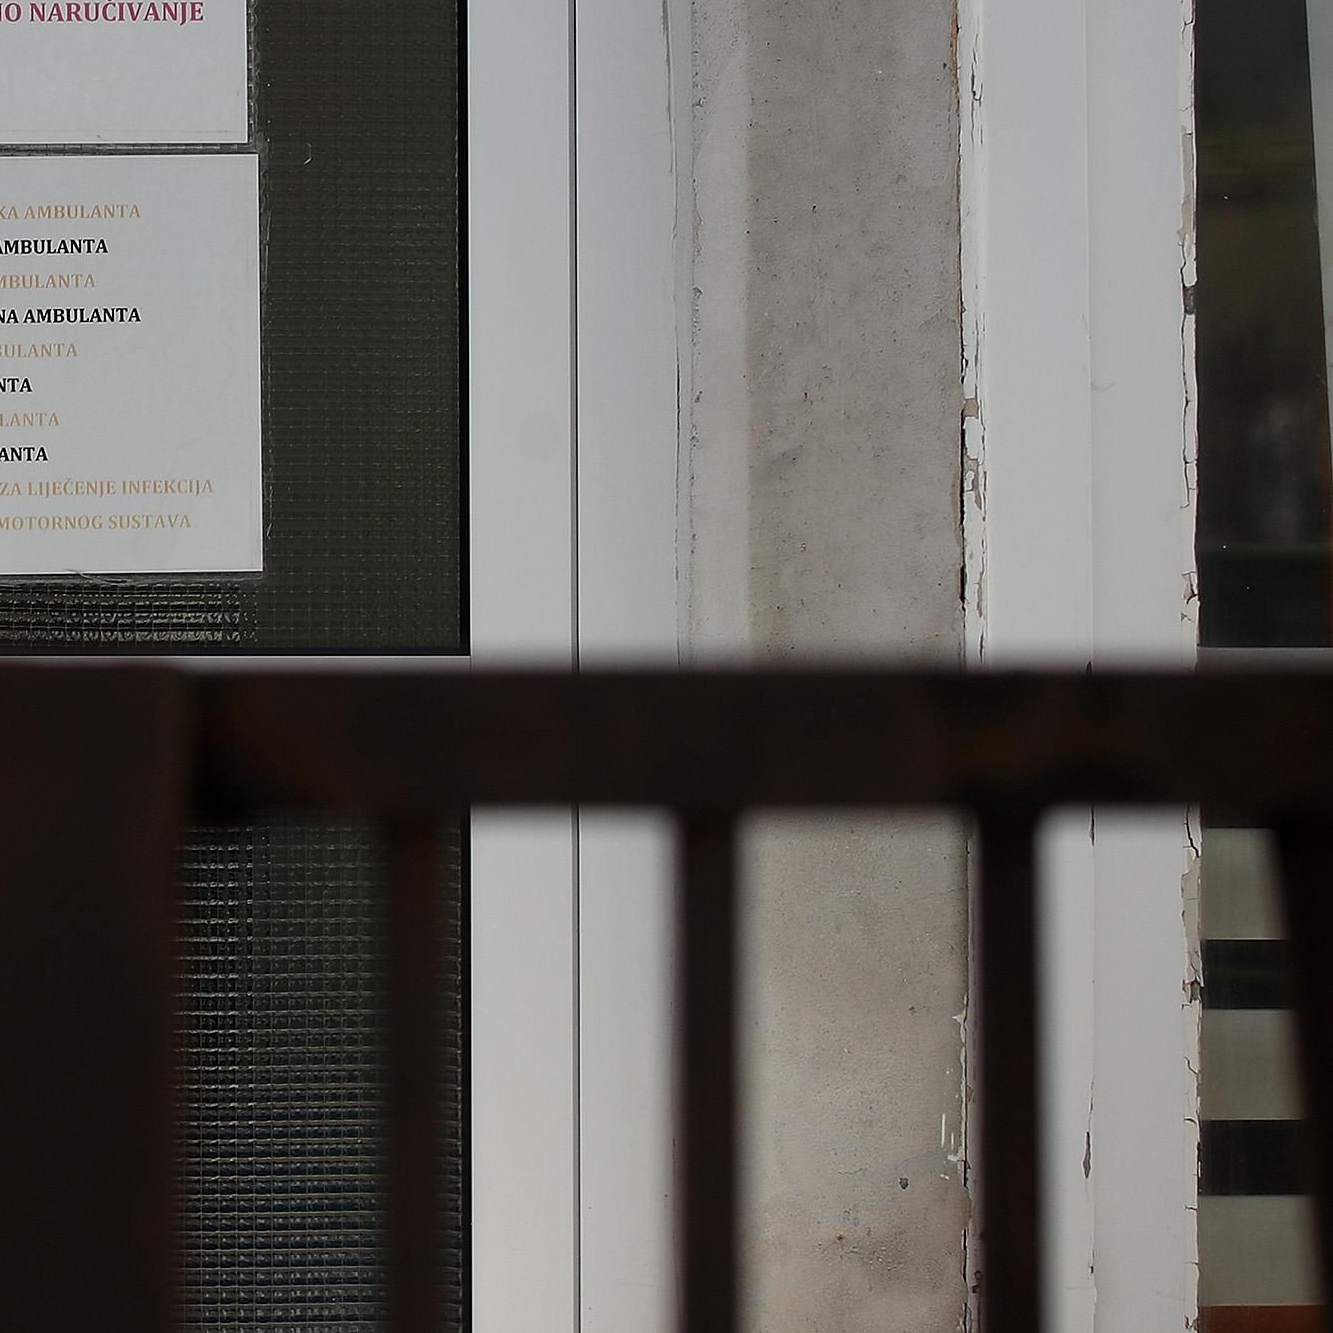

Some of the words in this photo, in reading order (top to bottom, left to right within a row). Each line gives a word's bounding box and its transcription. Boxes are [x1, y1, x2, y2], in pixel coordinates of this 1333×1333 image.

[24, 204, 141, 220] AMBULANTA
[22, 307, 142, 324] AMBULANTA
[0, 481, 22, 496] ZA
[28, 477, 117, 499] LIJEČENJE
[122, 479, 213, 497] INFEKCIJA
[108, 514, 191, 530] SUSTAVA
